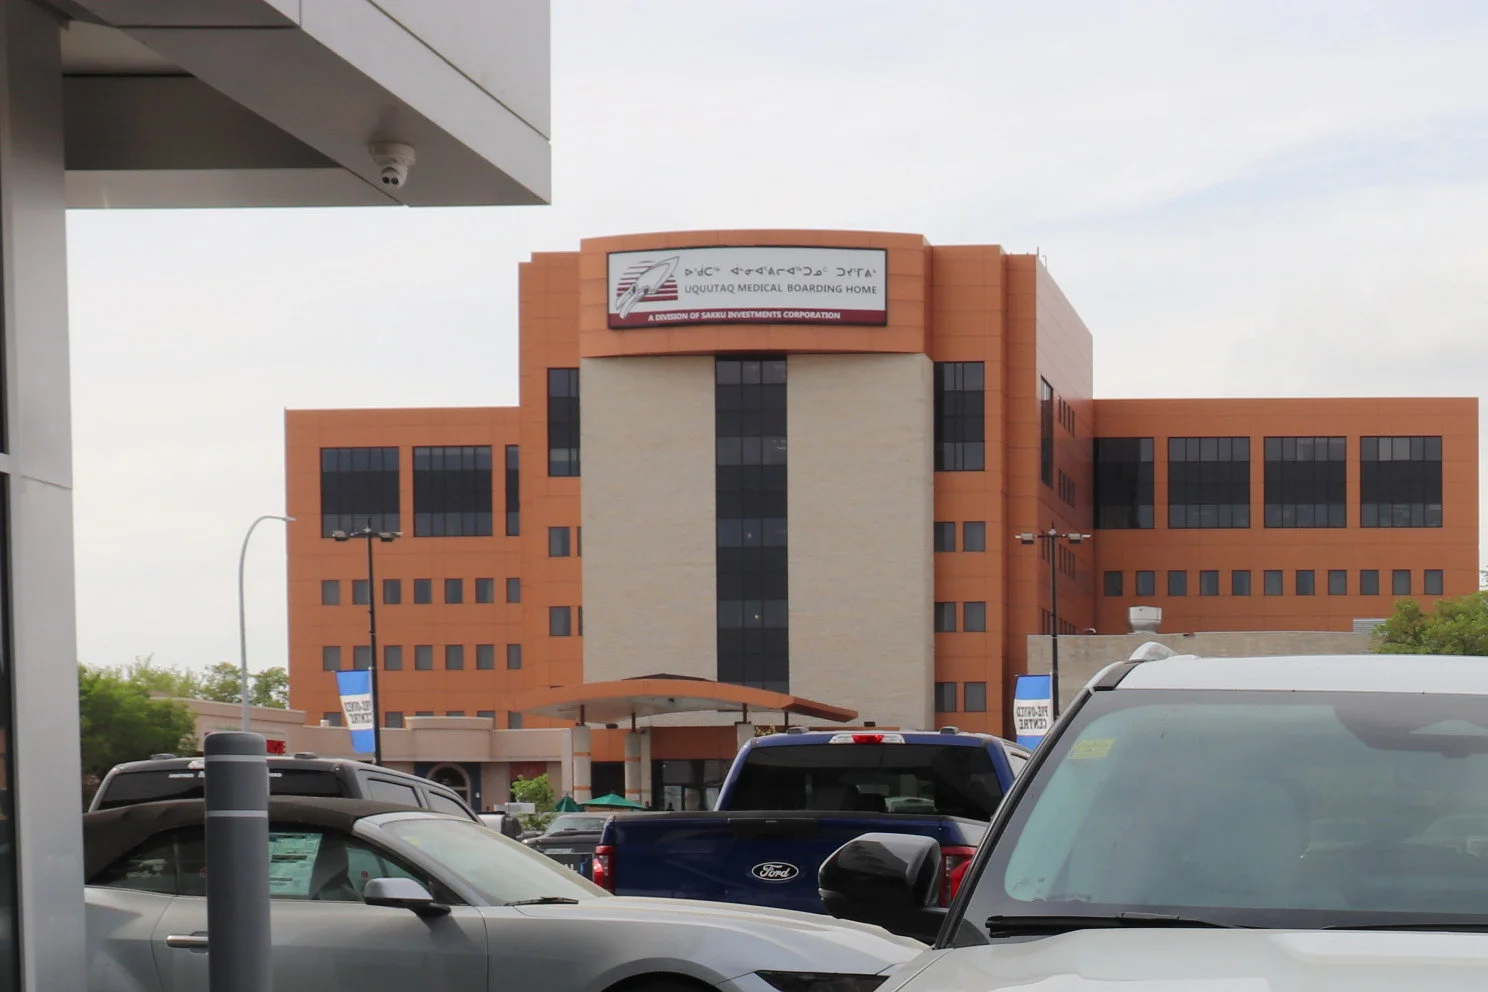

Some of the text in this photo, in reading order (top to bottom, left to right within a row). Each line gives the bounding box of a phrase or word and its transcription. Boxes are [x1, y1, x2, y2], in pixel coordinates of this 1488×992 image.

[685, 284, 877, 295] UQUUTAQ MEDICAL BOARDING HOME
[655, 313, 688, 321] DIVISION
[701, 311, 726, 319] SAKKU
[783, 311, 841, 319] CORPORATION
[759, 864, 791, 878] Ford
